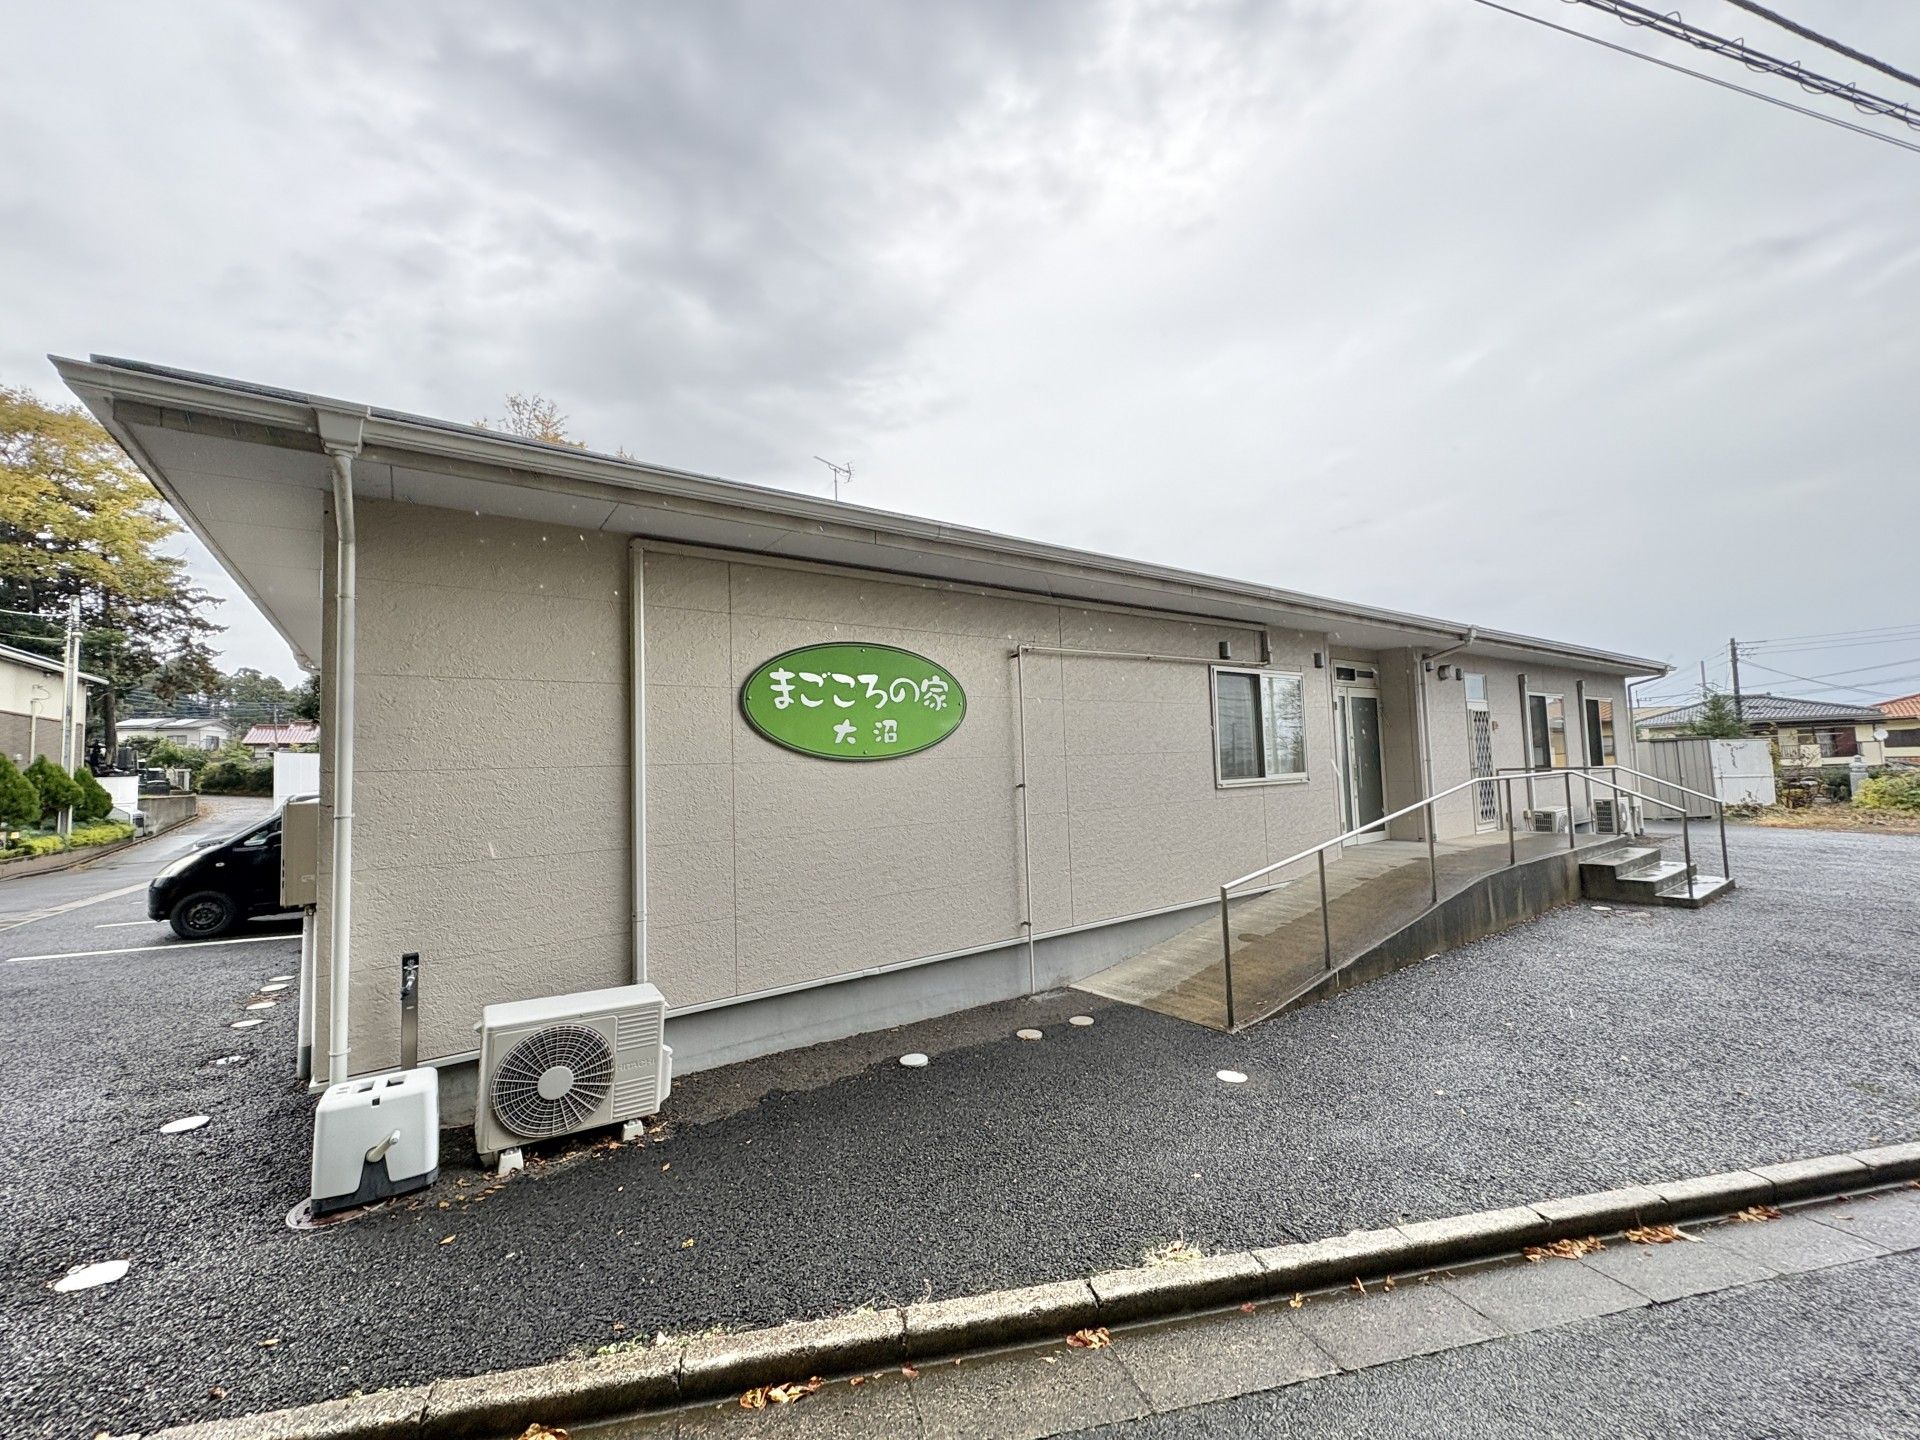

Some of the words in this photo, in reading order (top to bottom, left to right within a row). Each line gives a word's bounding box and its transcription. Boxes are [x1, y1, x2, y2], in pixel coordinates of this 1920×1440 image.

[769, 667, 949, 711] まごころの家
[616, 1056, 656, 1072] HITACHI
